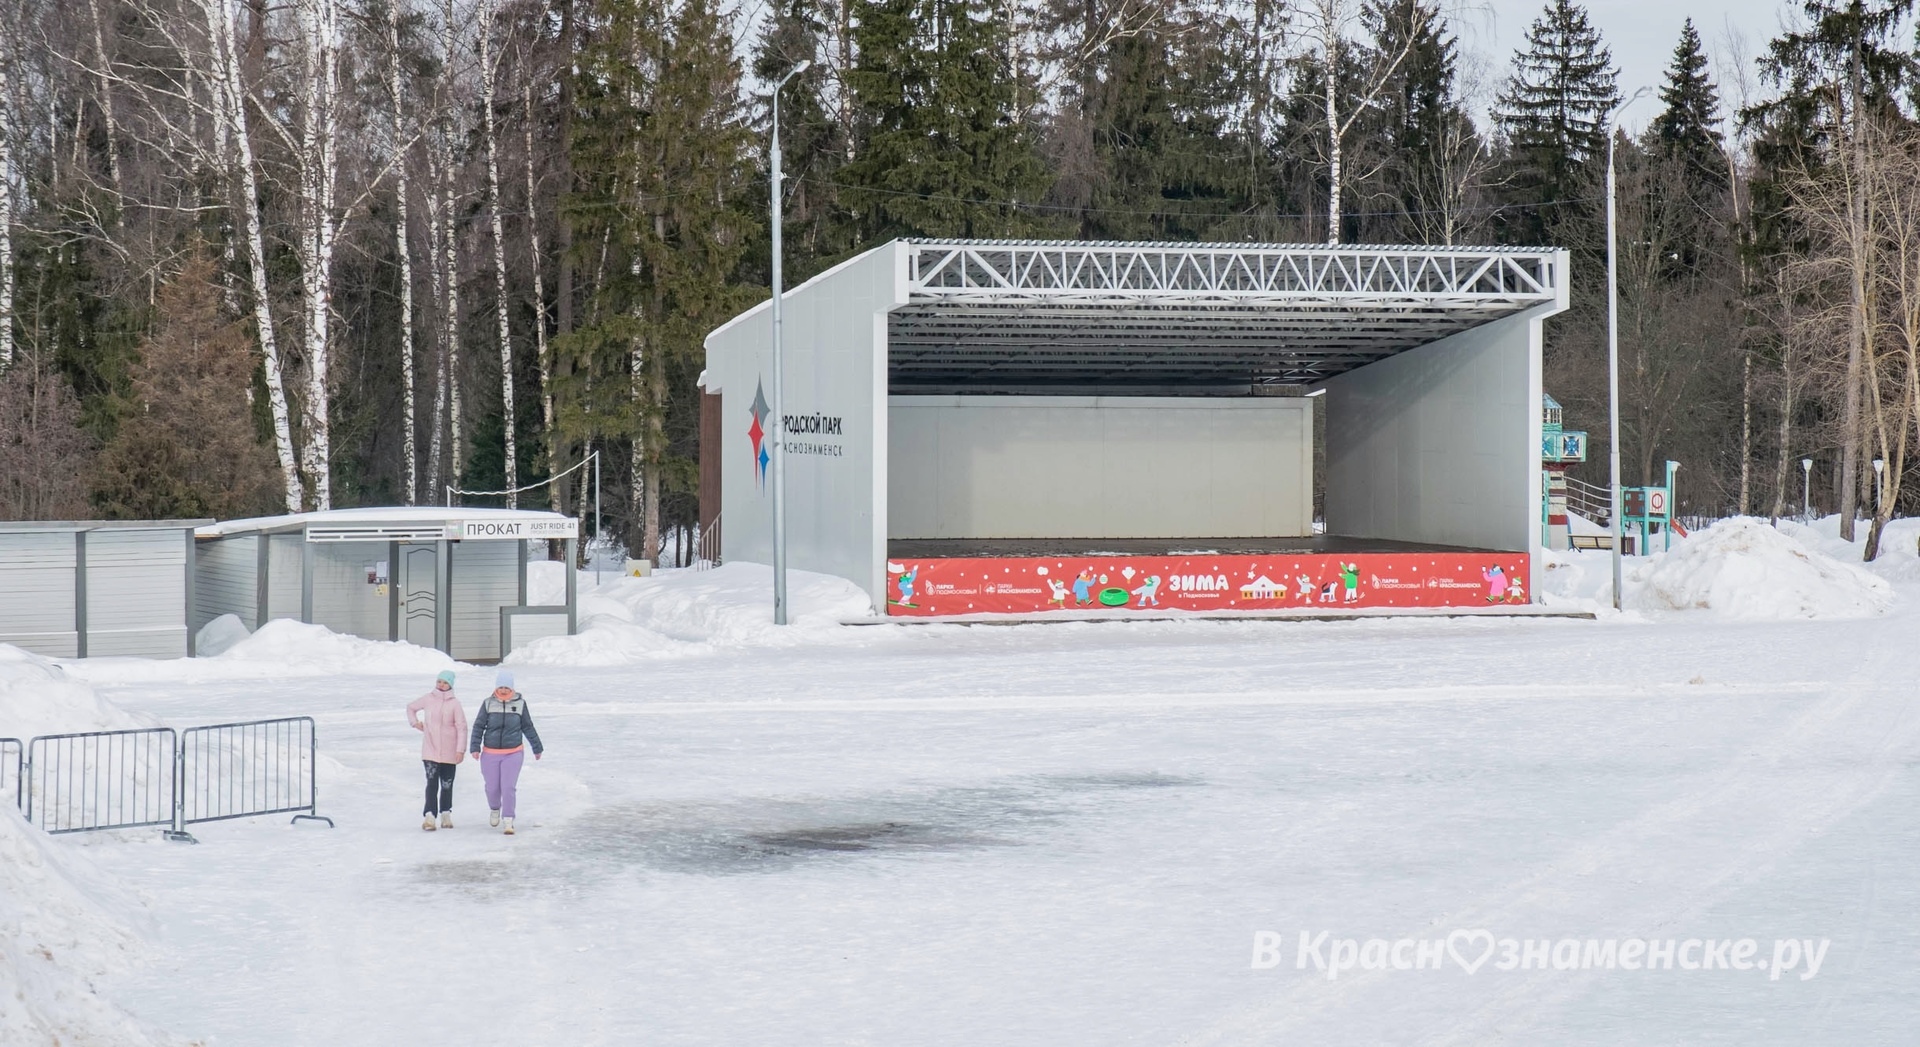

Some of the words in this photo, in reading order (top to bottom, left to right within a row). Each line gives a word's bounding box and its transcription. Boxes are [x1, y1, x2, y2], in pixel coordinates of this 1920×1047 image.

[783, 412, 821, 435] РОДСКОЙ
[822, 416, 842, 435] ПАРК
[784, 442, 842, 456] АСНОЗНАМЕНСК
[467, 523, 522, 535] ПРОКАТ
[1169, 574, 1230, 591] ЗИМА
